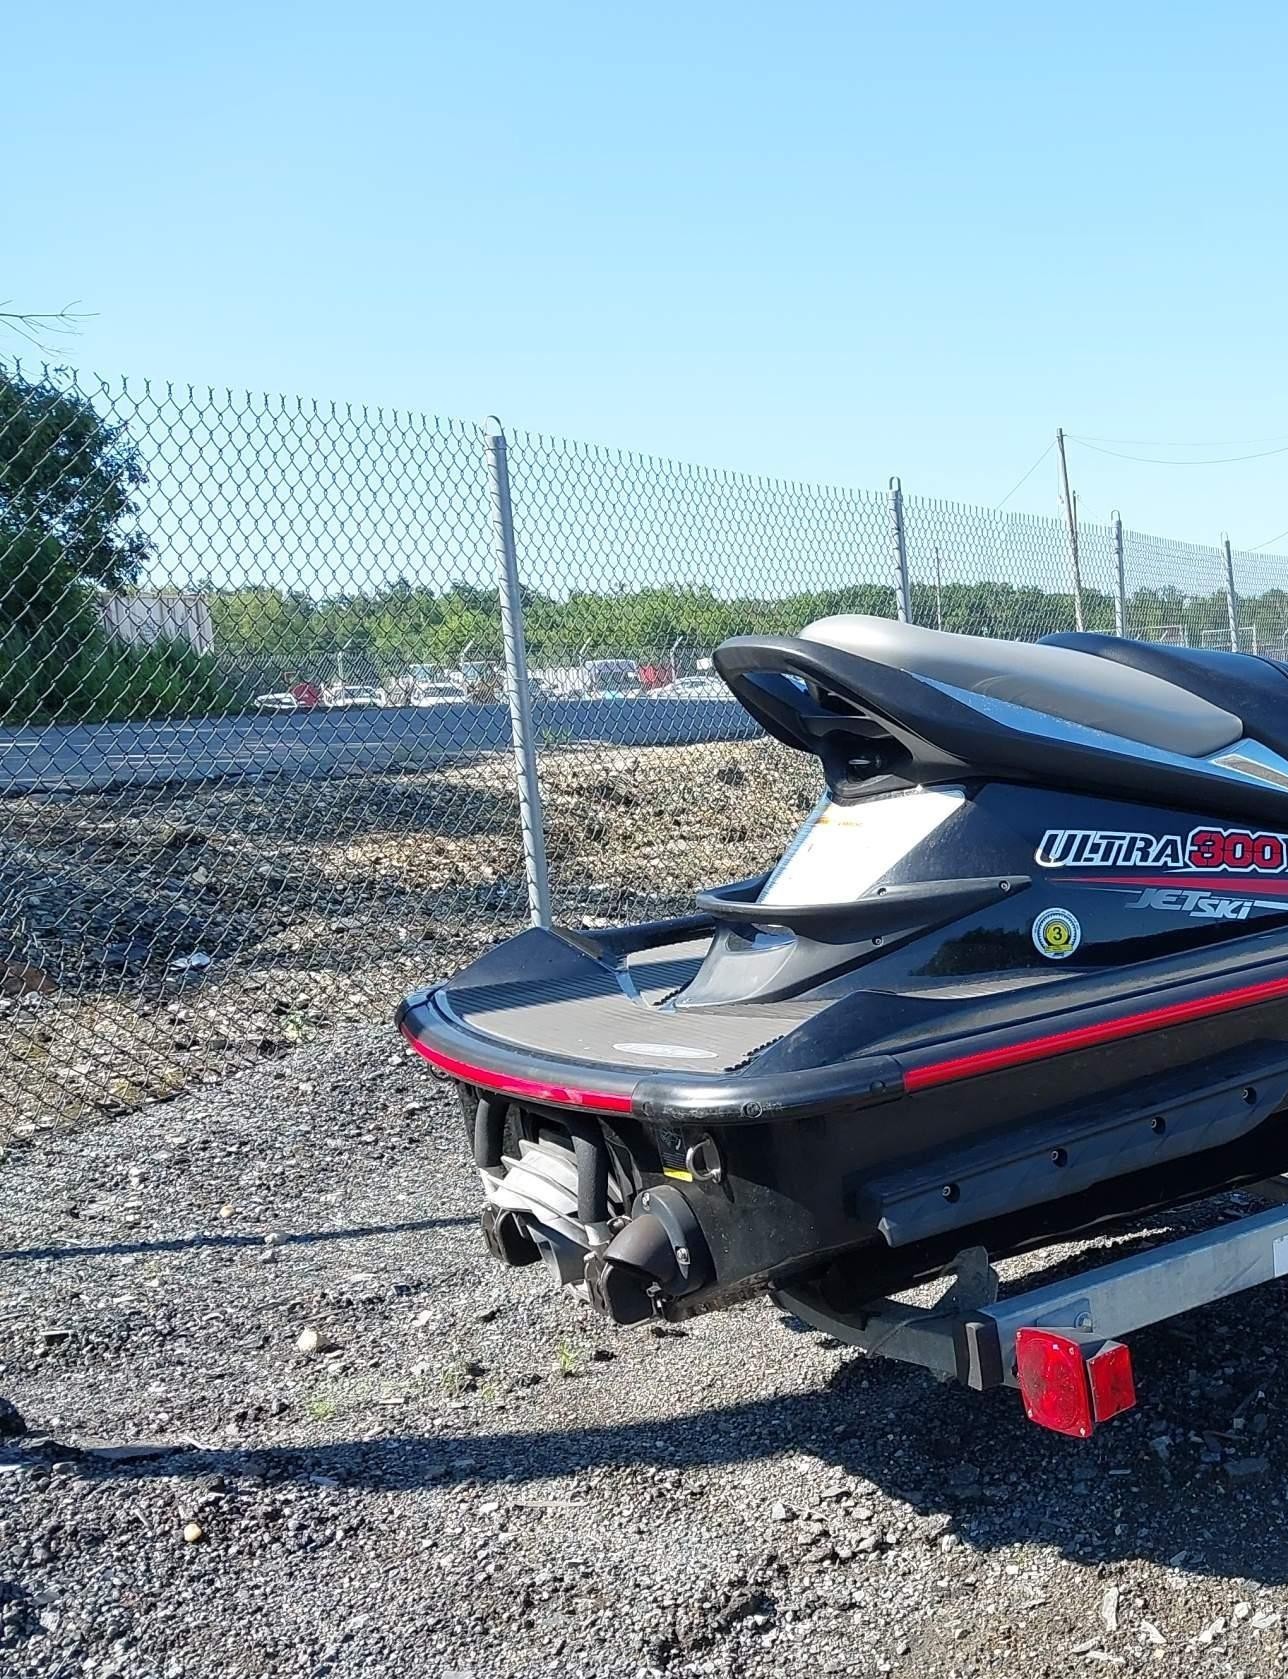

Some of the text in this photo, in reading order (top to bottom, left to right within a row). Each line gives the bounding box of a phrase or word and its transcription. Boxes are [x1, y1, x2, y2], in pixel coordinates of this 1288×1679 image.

[1035, 829, 1184, 867] ULTRA
[1124, 888, 1212, 911] JET
[1052, 926, 1063, 941] 3
